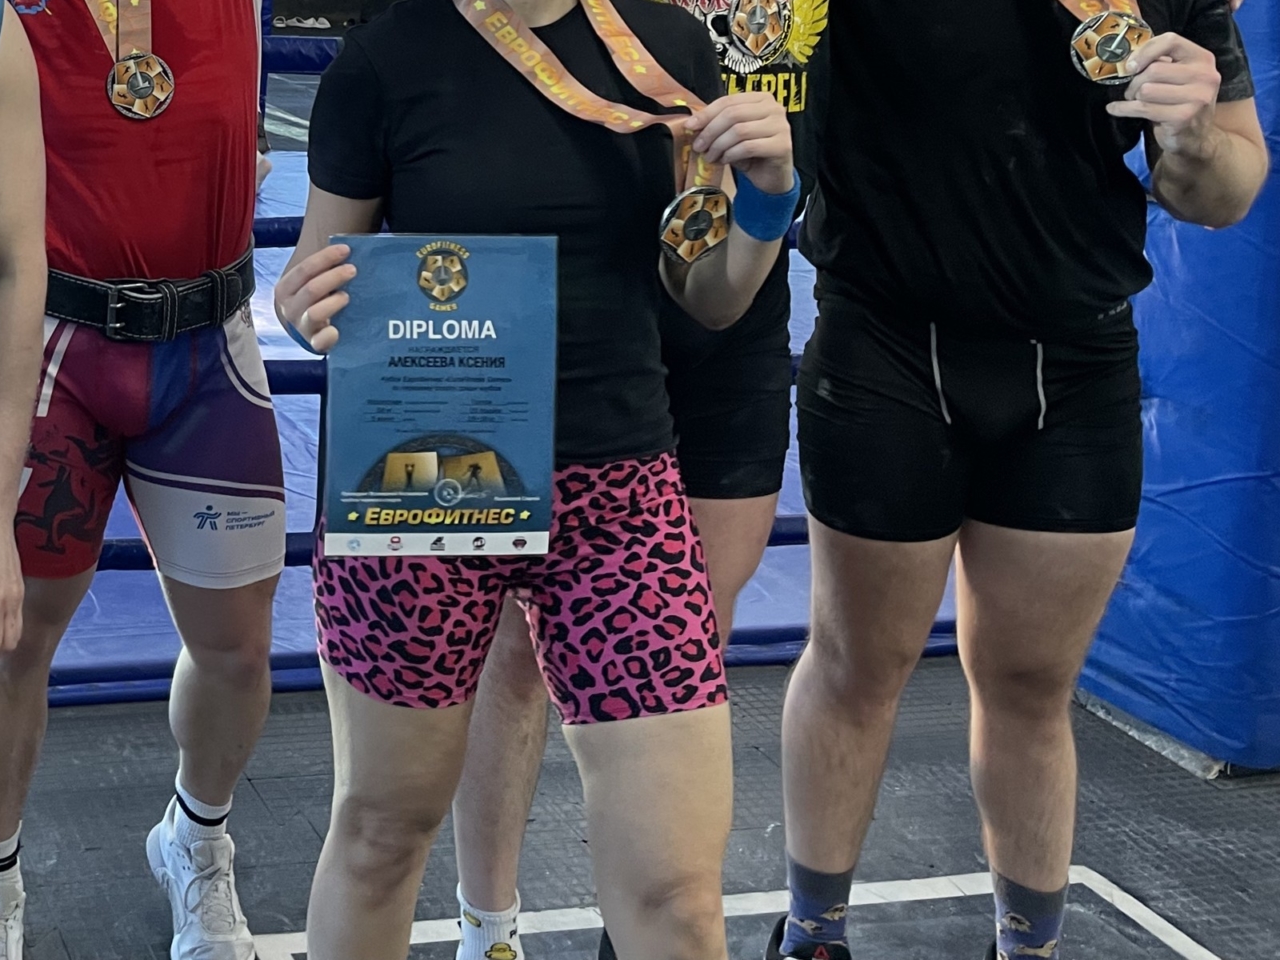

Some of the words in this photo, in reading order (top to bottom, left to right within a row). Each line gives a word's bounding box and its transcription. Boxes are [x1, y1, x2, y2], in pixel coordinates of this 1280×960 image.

[388, 319, 497, 339] DIPLOMA
[388, 356, 456, 368] АЛЕКСЕЕВА
[458, 356, 506, 368] КСЕНИЯ
[364, 507, 516, 525] ЕВРОФИТНЕС
